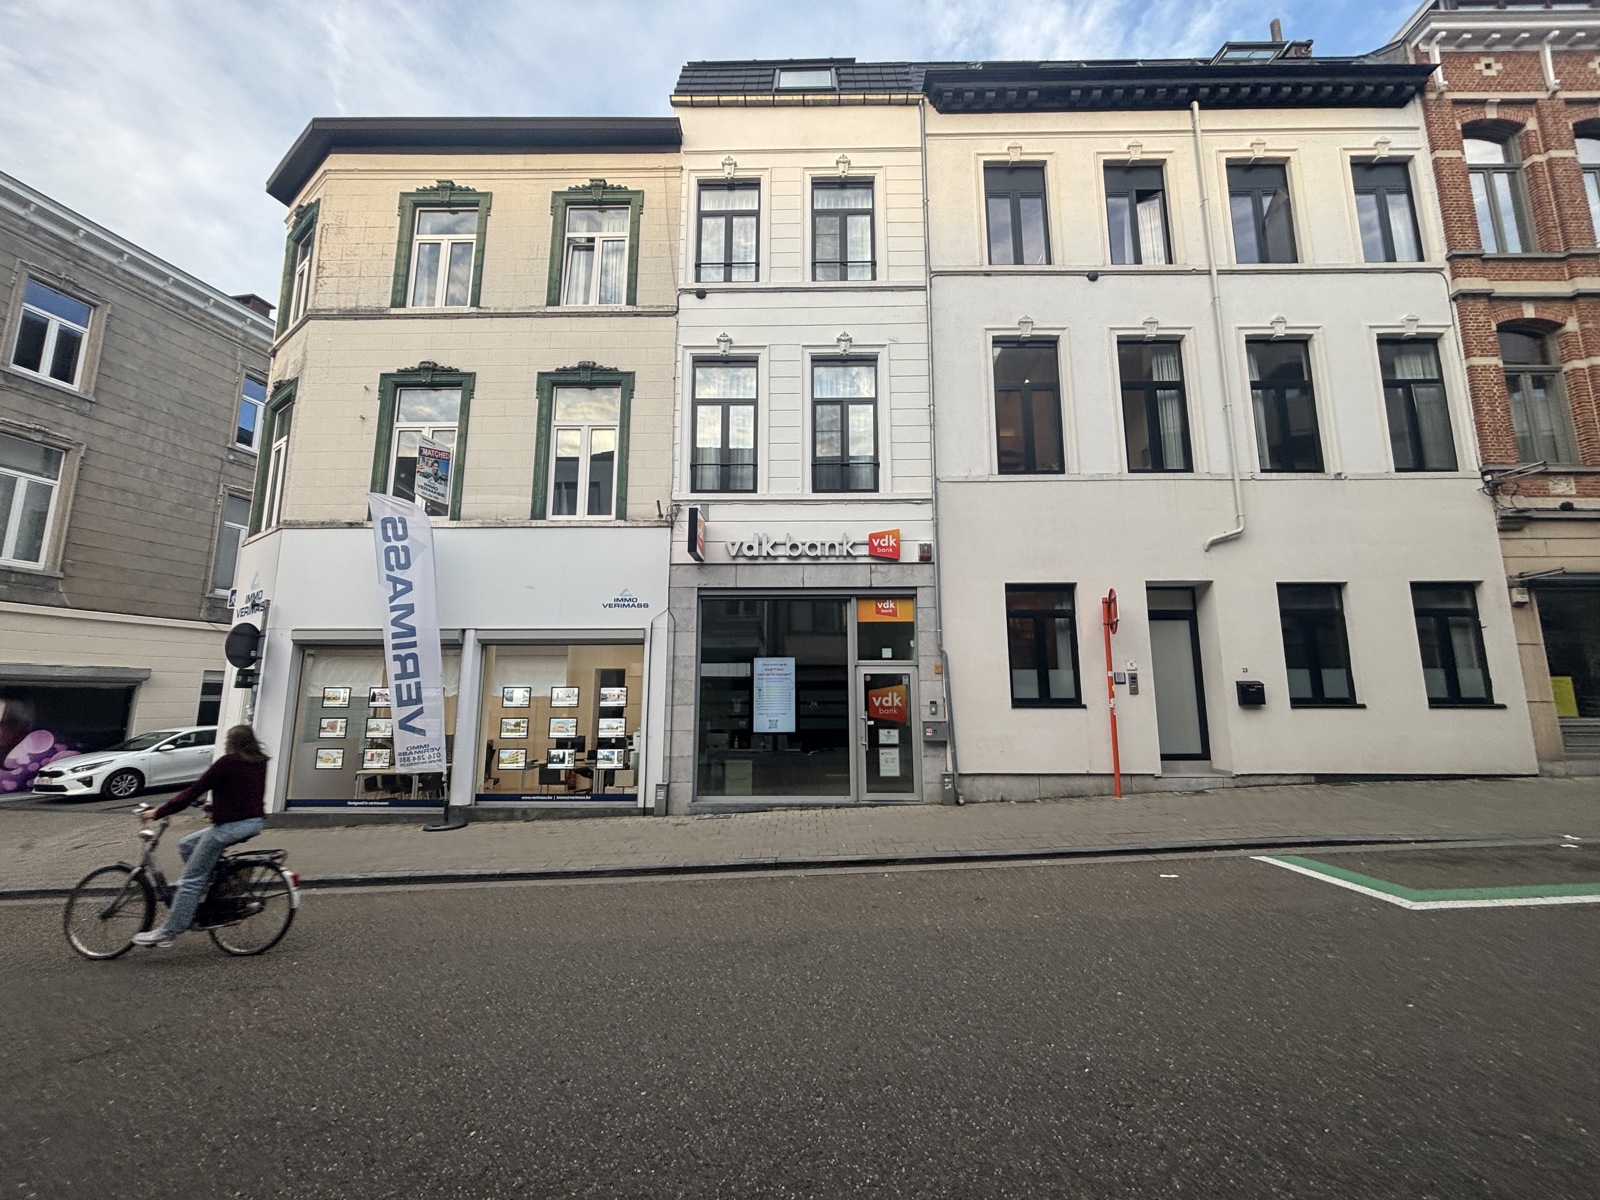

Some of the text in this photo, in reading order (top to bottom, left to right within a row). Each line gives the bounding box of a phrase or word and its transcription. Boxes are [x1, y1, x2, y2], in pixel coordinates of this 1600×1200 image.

[726, 533, 777, 557] vdk
[786, 532, 855, 556] bank
[872, 534, 897, 547] vdk
[877, 600, 896, 609] vdk
[872, 692, 903, 707] vdk
[879, 706, 898, 714] bank
